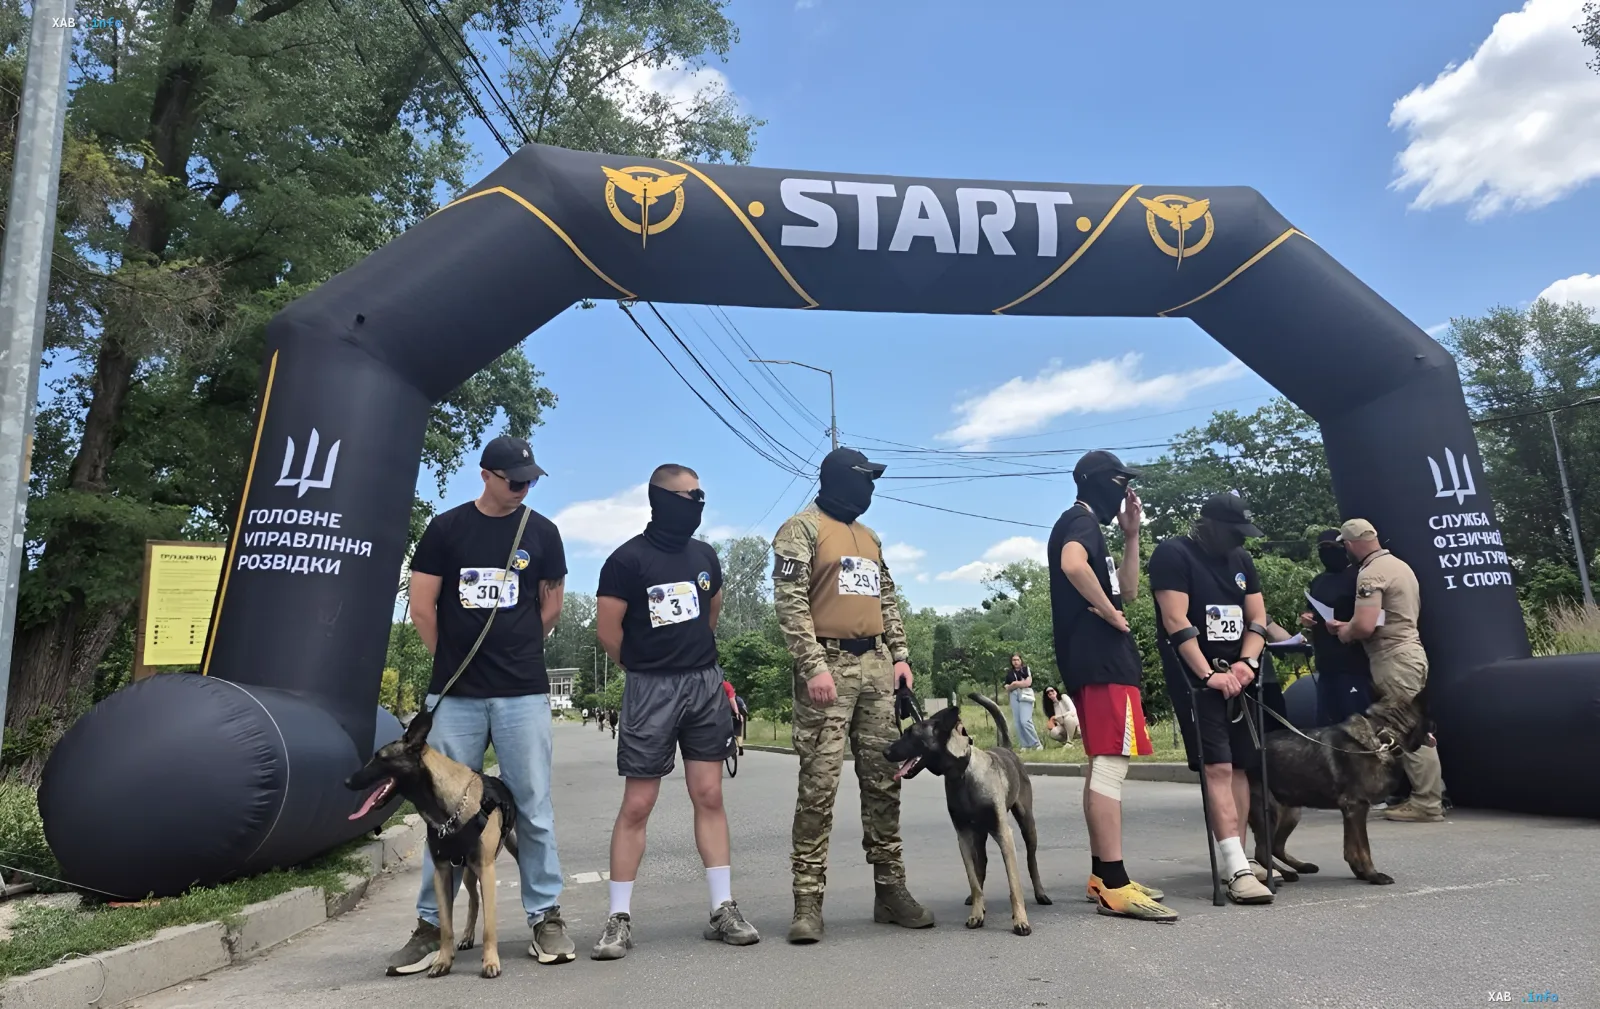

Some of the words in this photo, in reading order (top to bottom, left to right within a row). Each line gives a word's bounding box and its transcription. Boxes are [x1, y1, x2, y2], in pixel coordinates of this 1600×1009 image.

[780, 178, 1073, 257] START
[248, 509, 342, 528] ГОЛОВНЕ
[1429, 512, 1490, 530] СЛУЖБА
[244, 531, 372, 557] УПРАВЛІННЯ
[237, 554, 342, 575] РОЗВІДКИ
[853, 573, 870, 588] 29
[476, 585, 499, 600] 30
[670, 598, 682, 616] 3
[1220, 620, 1237, 633] 28
